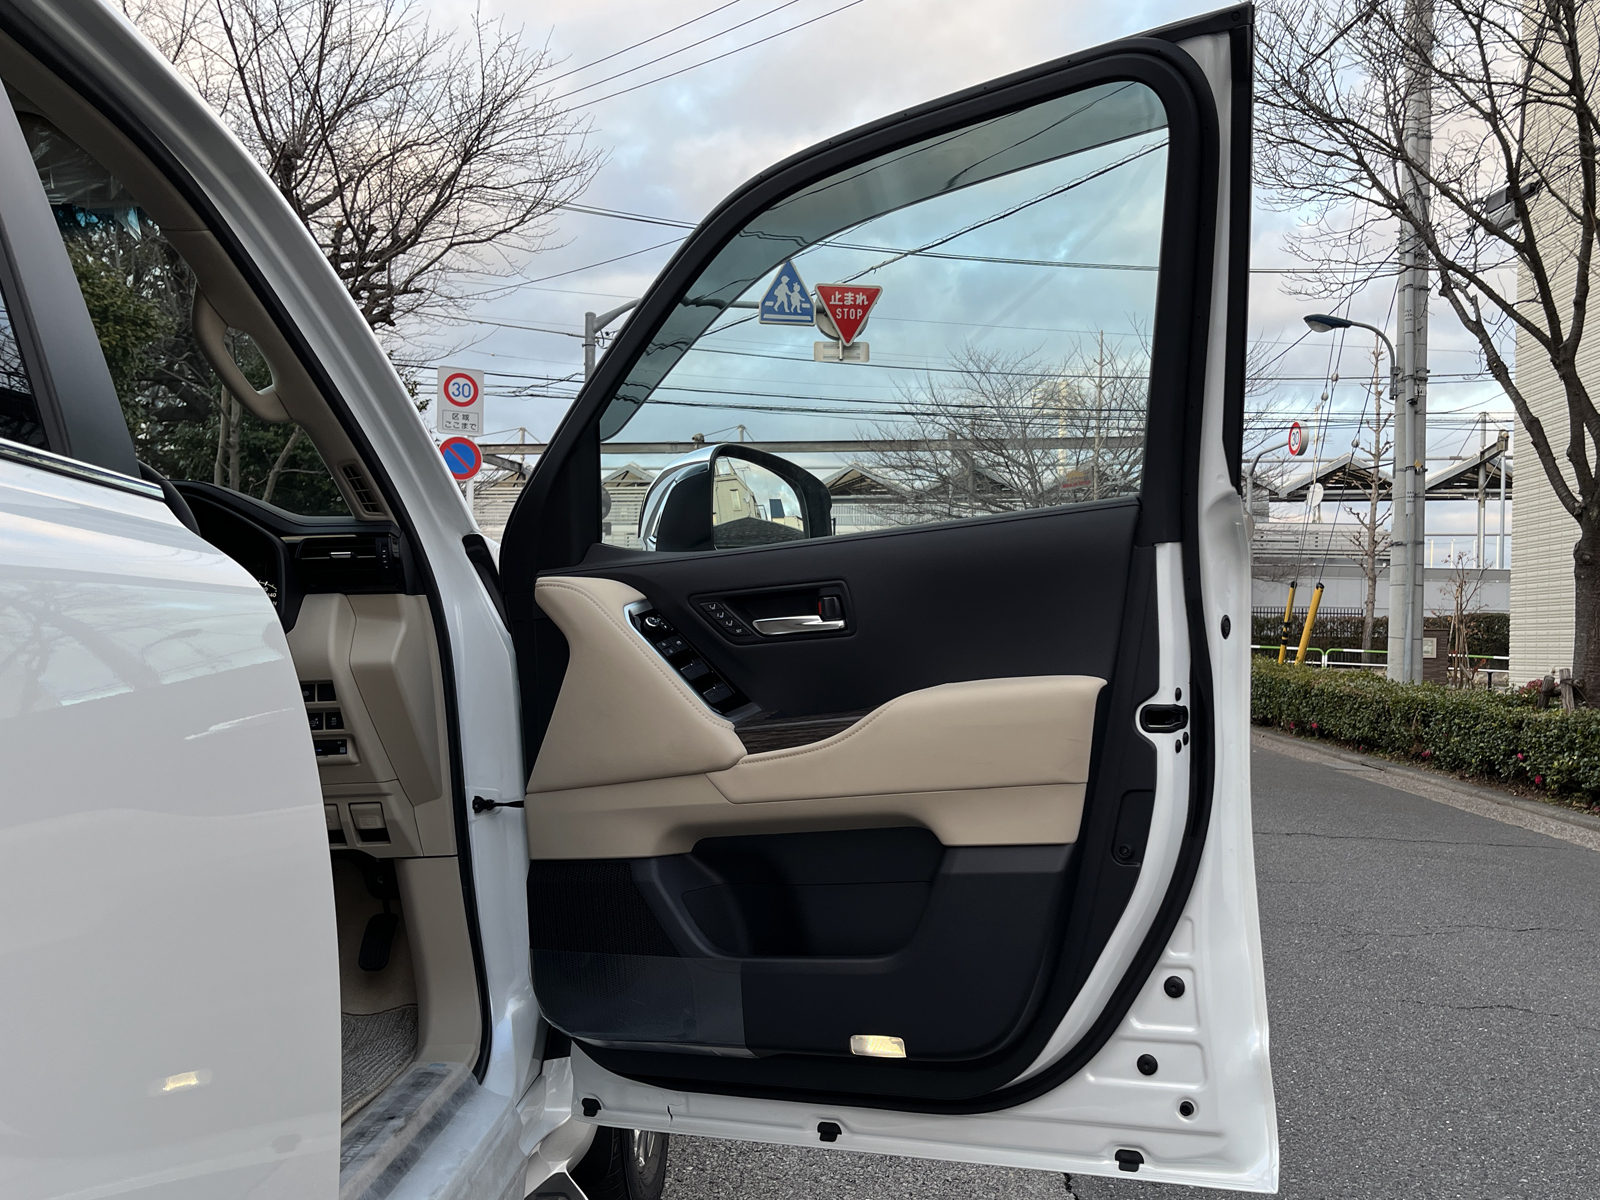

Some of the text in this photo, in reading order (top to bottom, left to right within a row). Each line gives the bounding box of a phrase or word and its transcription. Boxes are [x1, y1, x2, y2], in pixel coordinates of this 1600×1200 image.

[829, 290, 869, 306] 止まれ
[836, 308, 863, 320] STOP
[451, 382, 472, 398] 30
[451, 412, 470, 422] 区域
[444, 420, 477, 431] ここまで
[1291, 431, 1299, 447] 30
